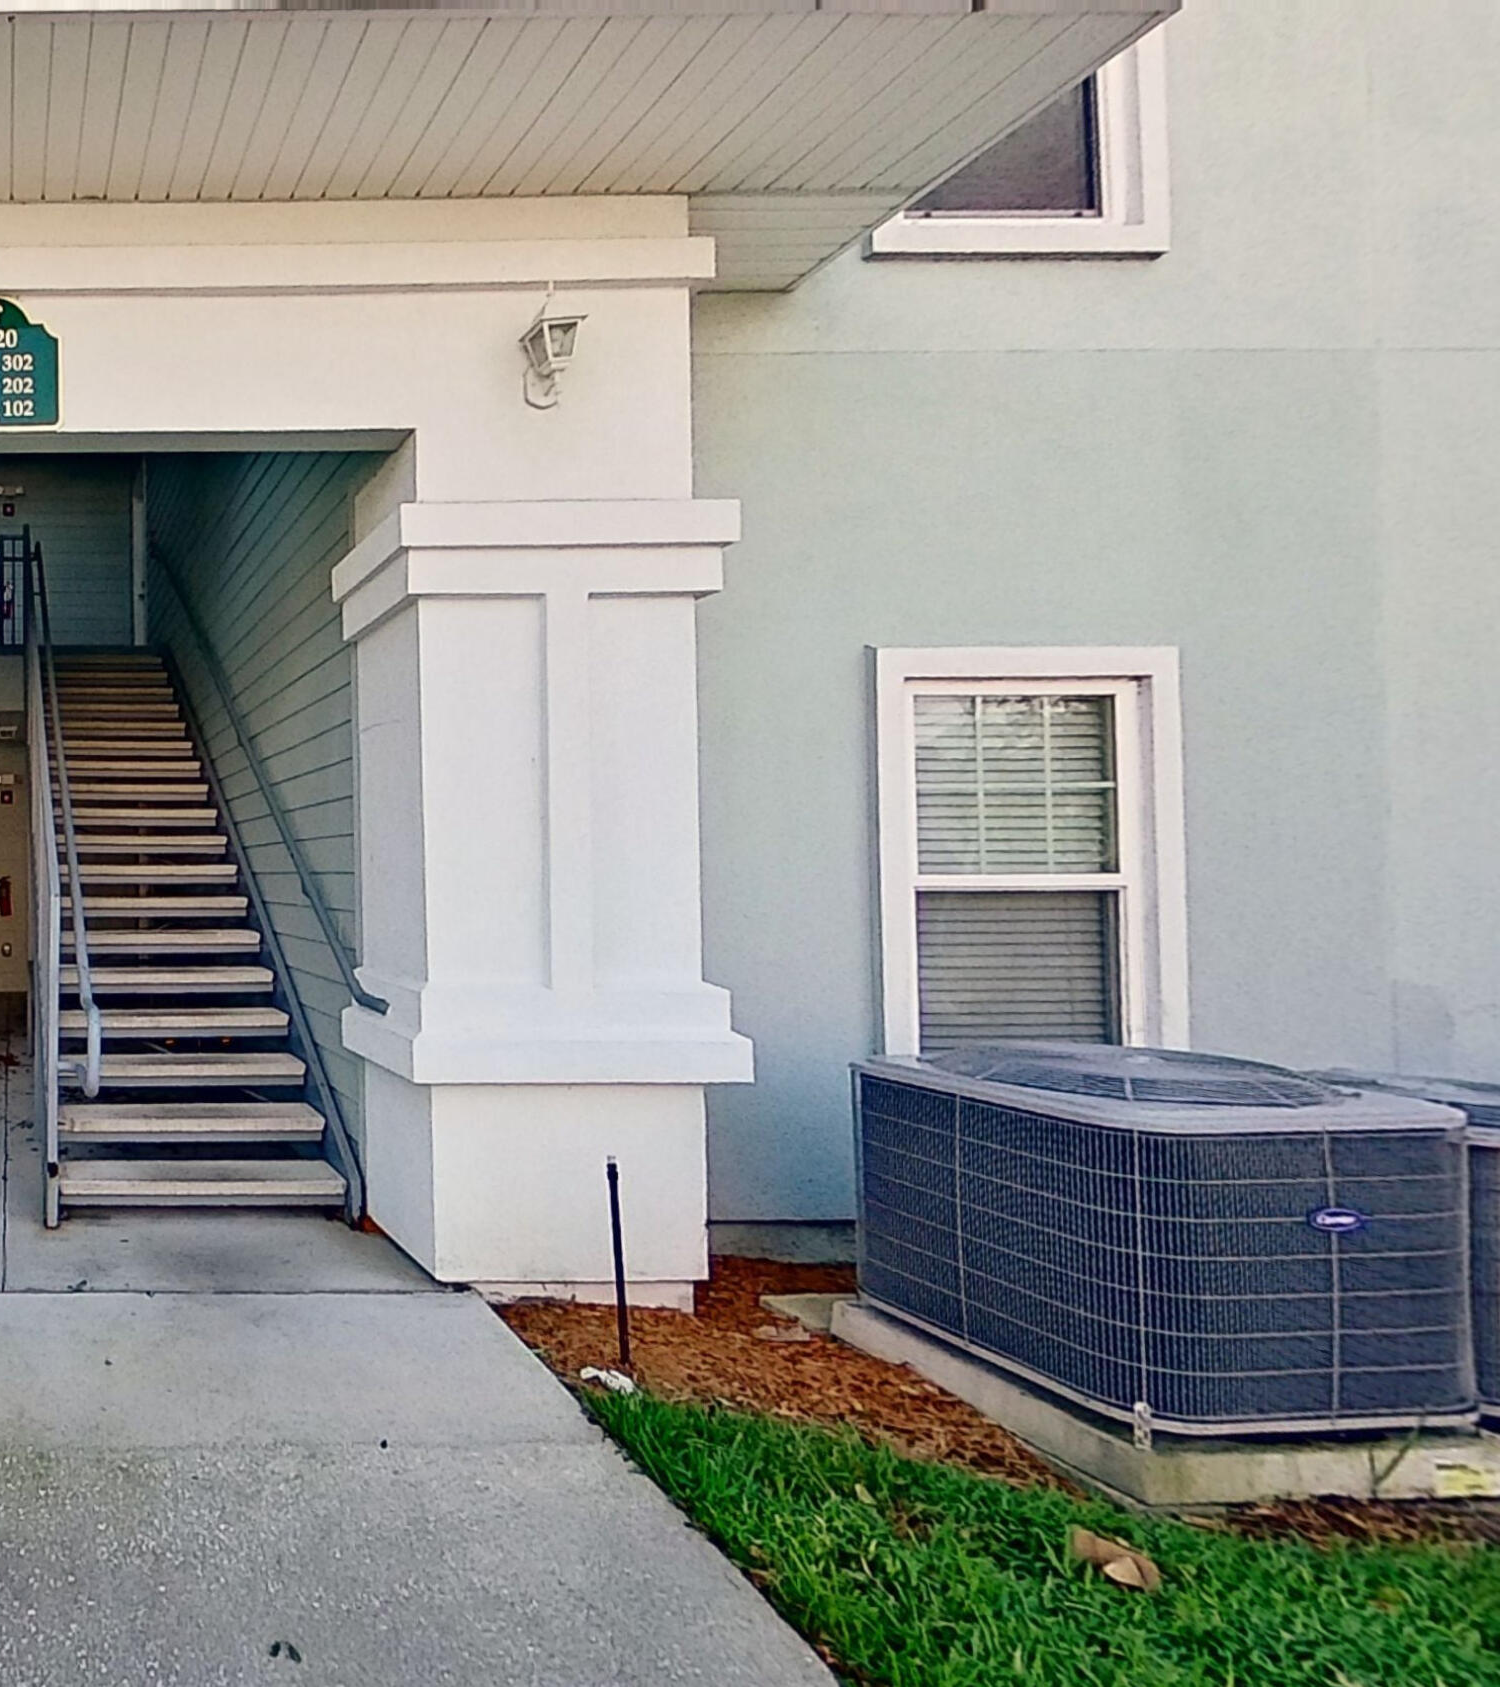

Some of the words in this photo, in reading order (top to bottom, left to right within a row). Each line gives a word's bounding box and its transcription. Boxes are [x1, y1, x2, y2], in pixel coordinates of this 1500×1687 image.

[1, 354, 34, 371] 302
[2, 377, 35, 394] 202
[3, 400, 35, 416] 102
